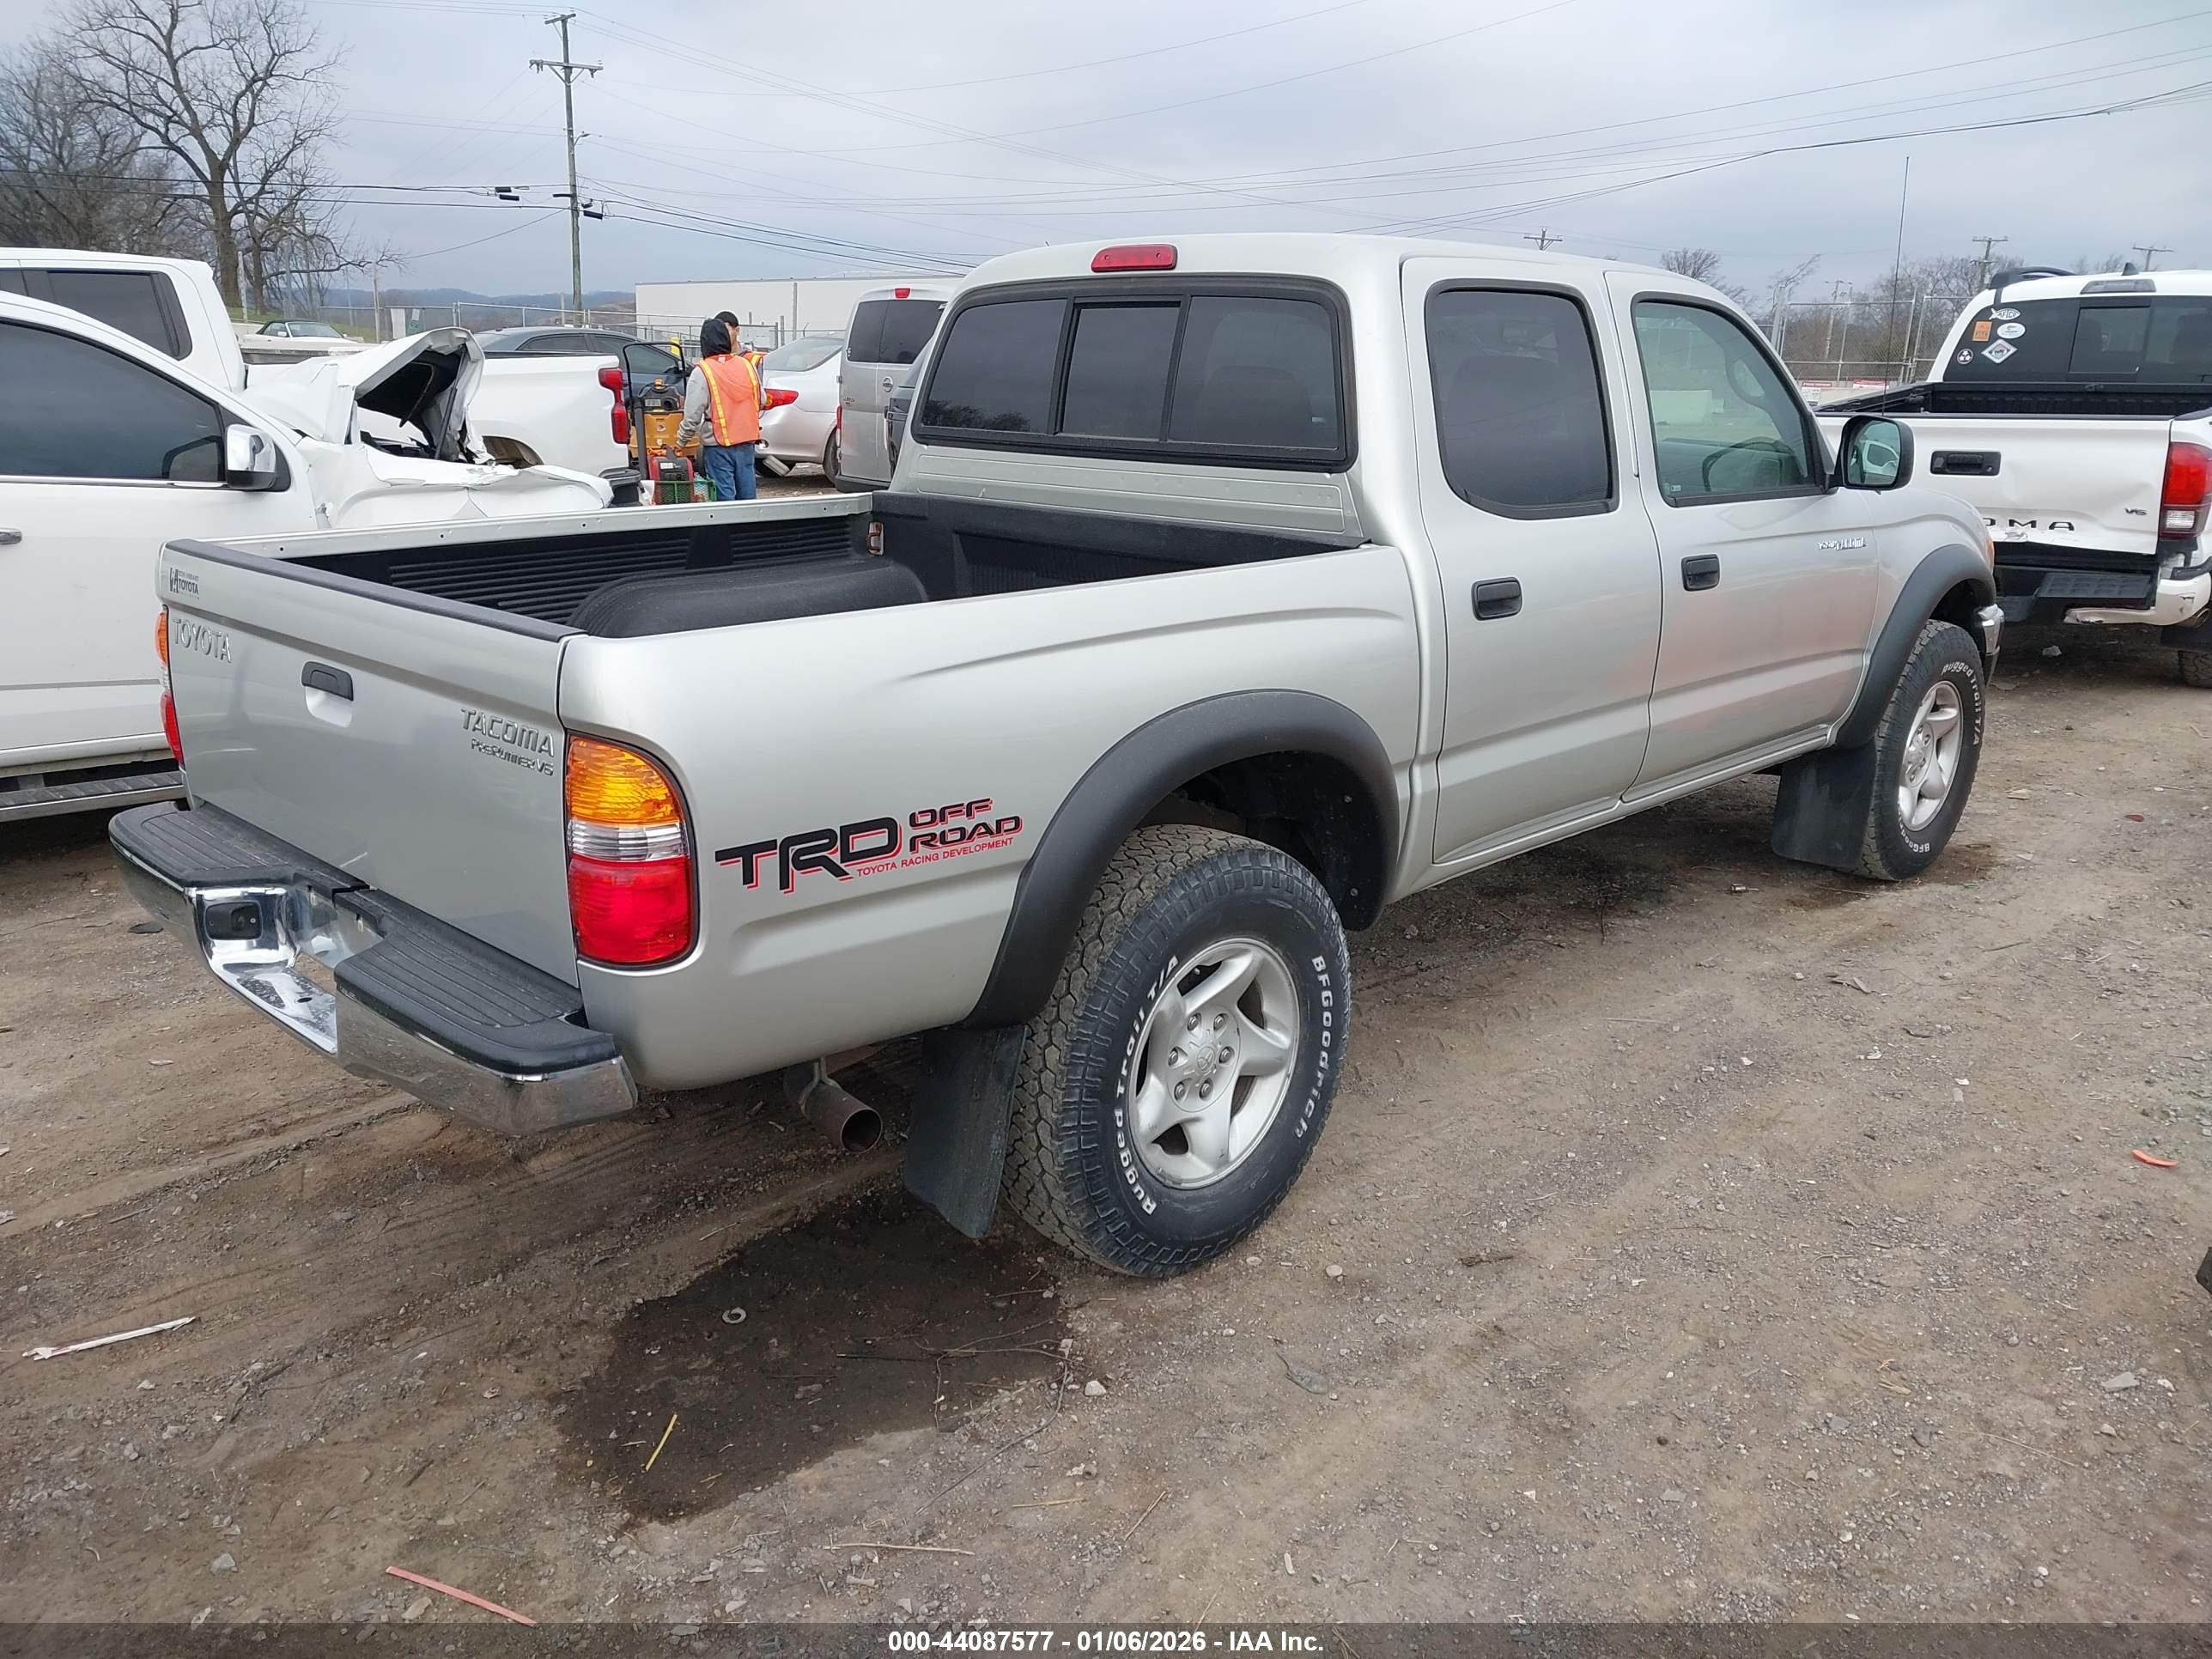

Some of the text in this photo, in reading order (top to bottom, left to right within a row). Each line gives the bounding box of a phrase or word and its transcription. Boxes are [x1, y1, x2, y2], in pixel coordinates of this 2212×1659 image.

[179, 578, 200, 595] TOYOTA
[172, 618, 231, 664] TOYOTA
[460, 708, 555, 757] TACOMA
[536, 757, 555, 777] V6
[908, 797, 994, 830] OFF
[909, 815, 1024, 854] ROAD
[714, 816, 903, 895] TRD
[857, 836, 1014, 878] TOYOTA RACING DEVELOPMENT
[1115, 954, 1179, 1216] Rugged Trail T/A
